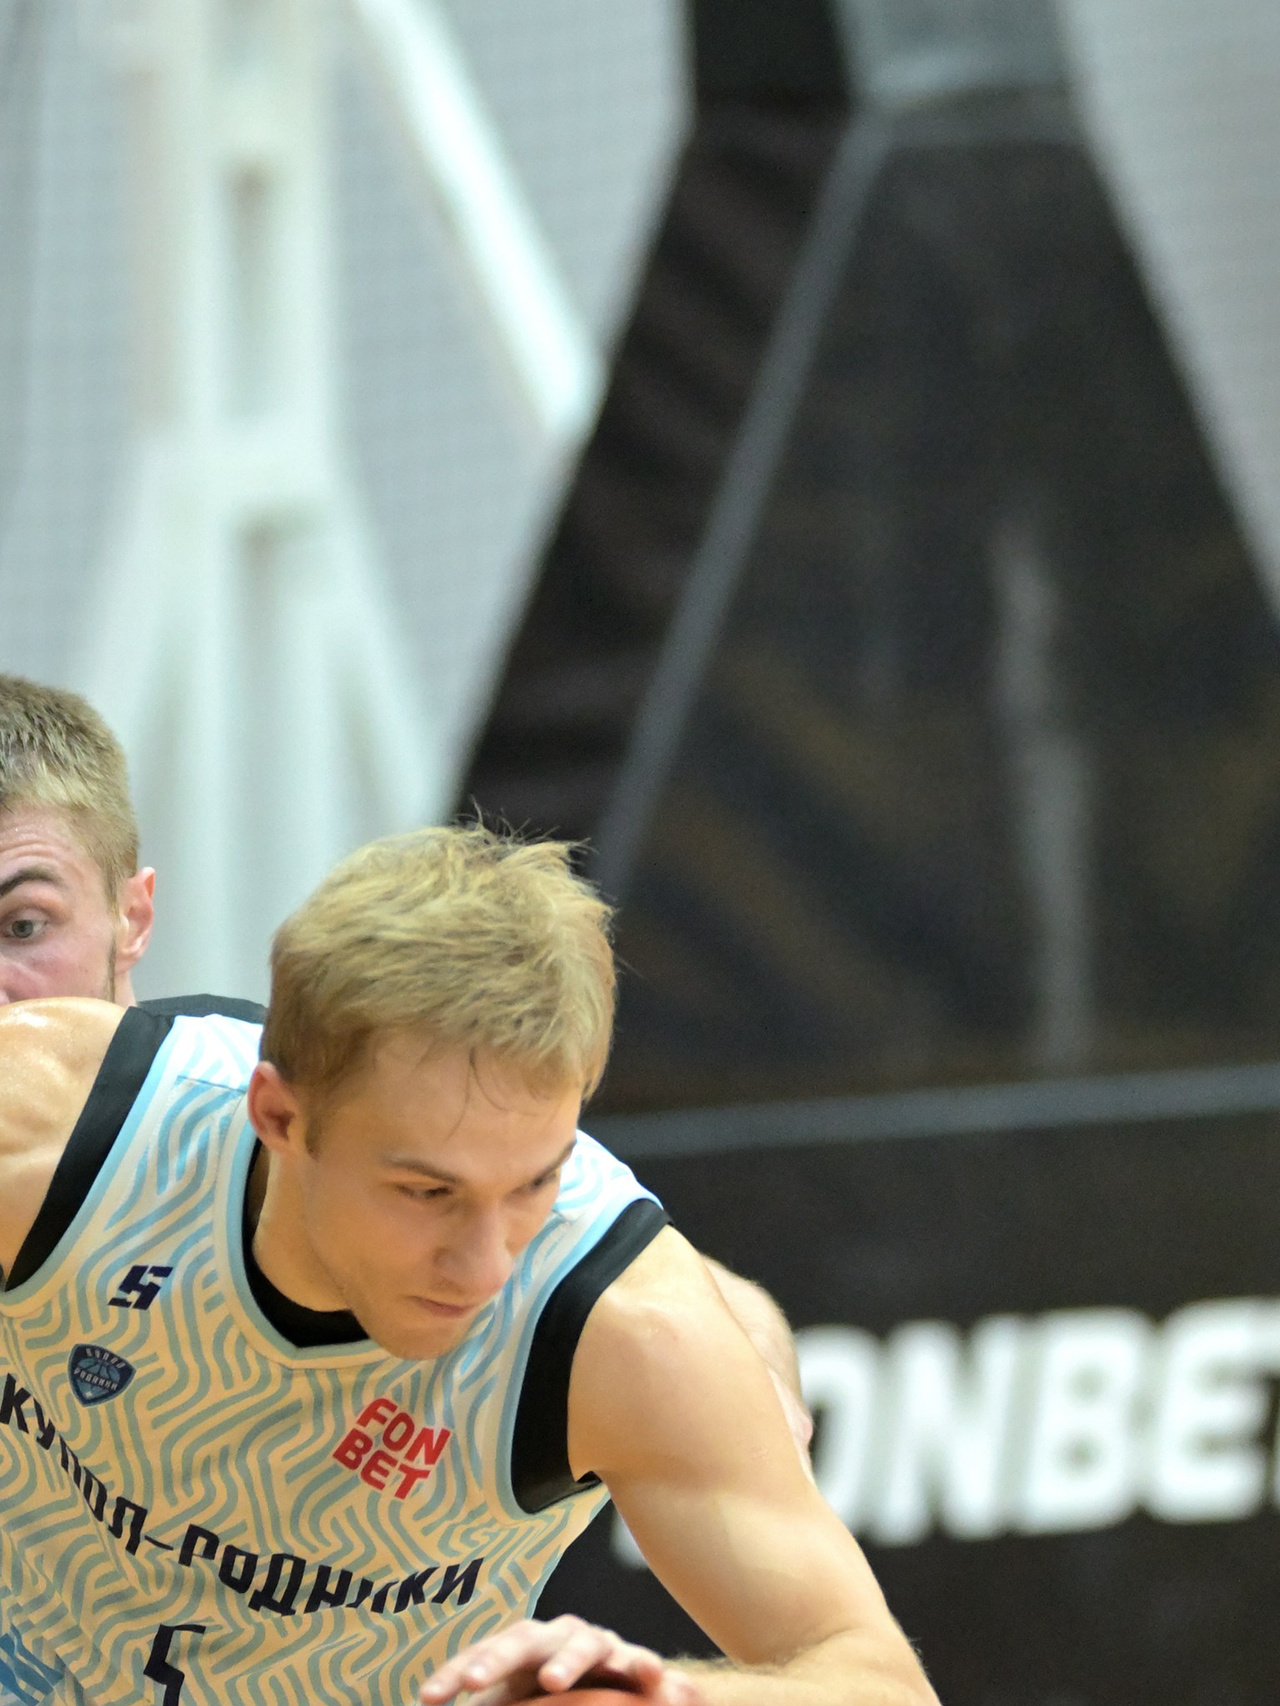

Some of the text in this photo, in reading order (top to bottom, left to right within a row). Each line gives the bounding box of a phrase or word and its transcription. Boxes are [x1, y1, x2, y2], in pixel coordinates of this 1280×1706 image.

[332, 1427, 431, 1501] BET
[356, 1397, 451, 1466] FON
[610, 1297, 1280, 1568] ONBE
